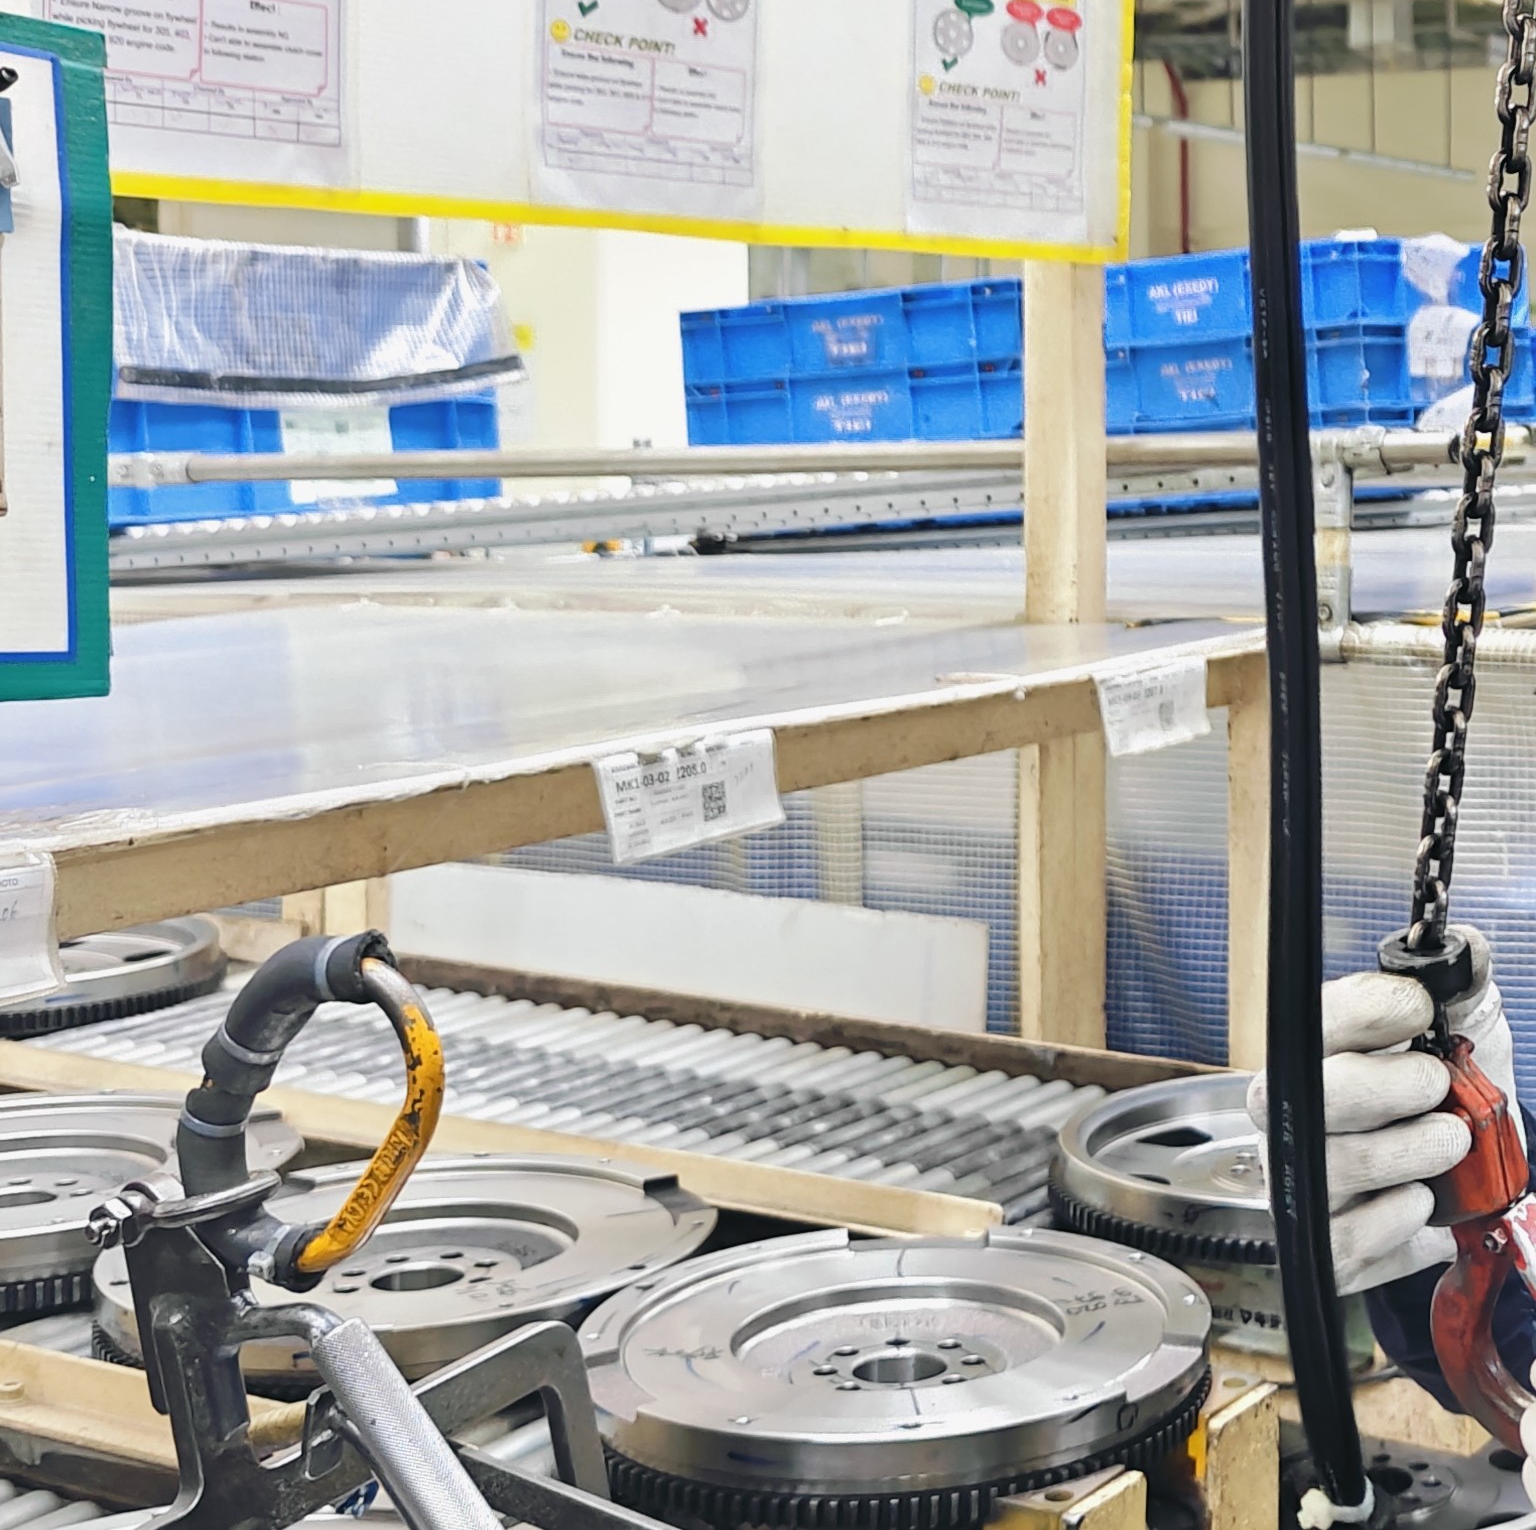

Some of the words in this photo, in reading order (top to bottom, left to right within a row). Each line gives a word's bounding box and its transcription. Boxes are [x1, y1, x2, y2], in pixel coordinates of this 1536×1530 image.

[573, 28, 623, 47] CHECK
[628, 37, 676, 56] POINT!
[939, 81, 980, 97] CHECK
